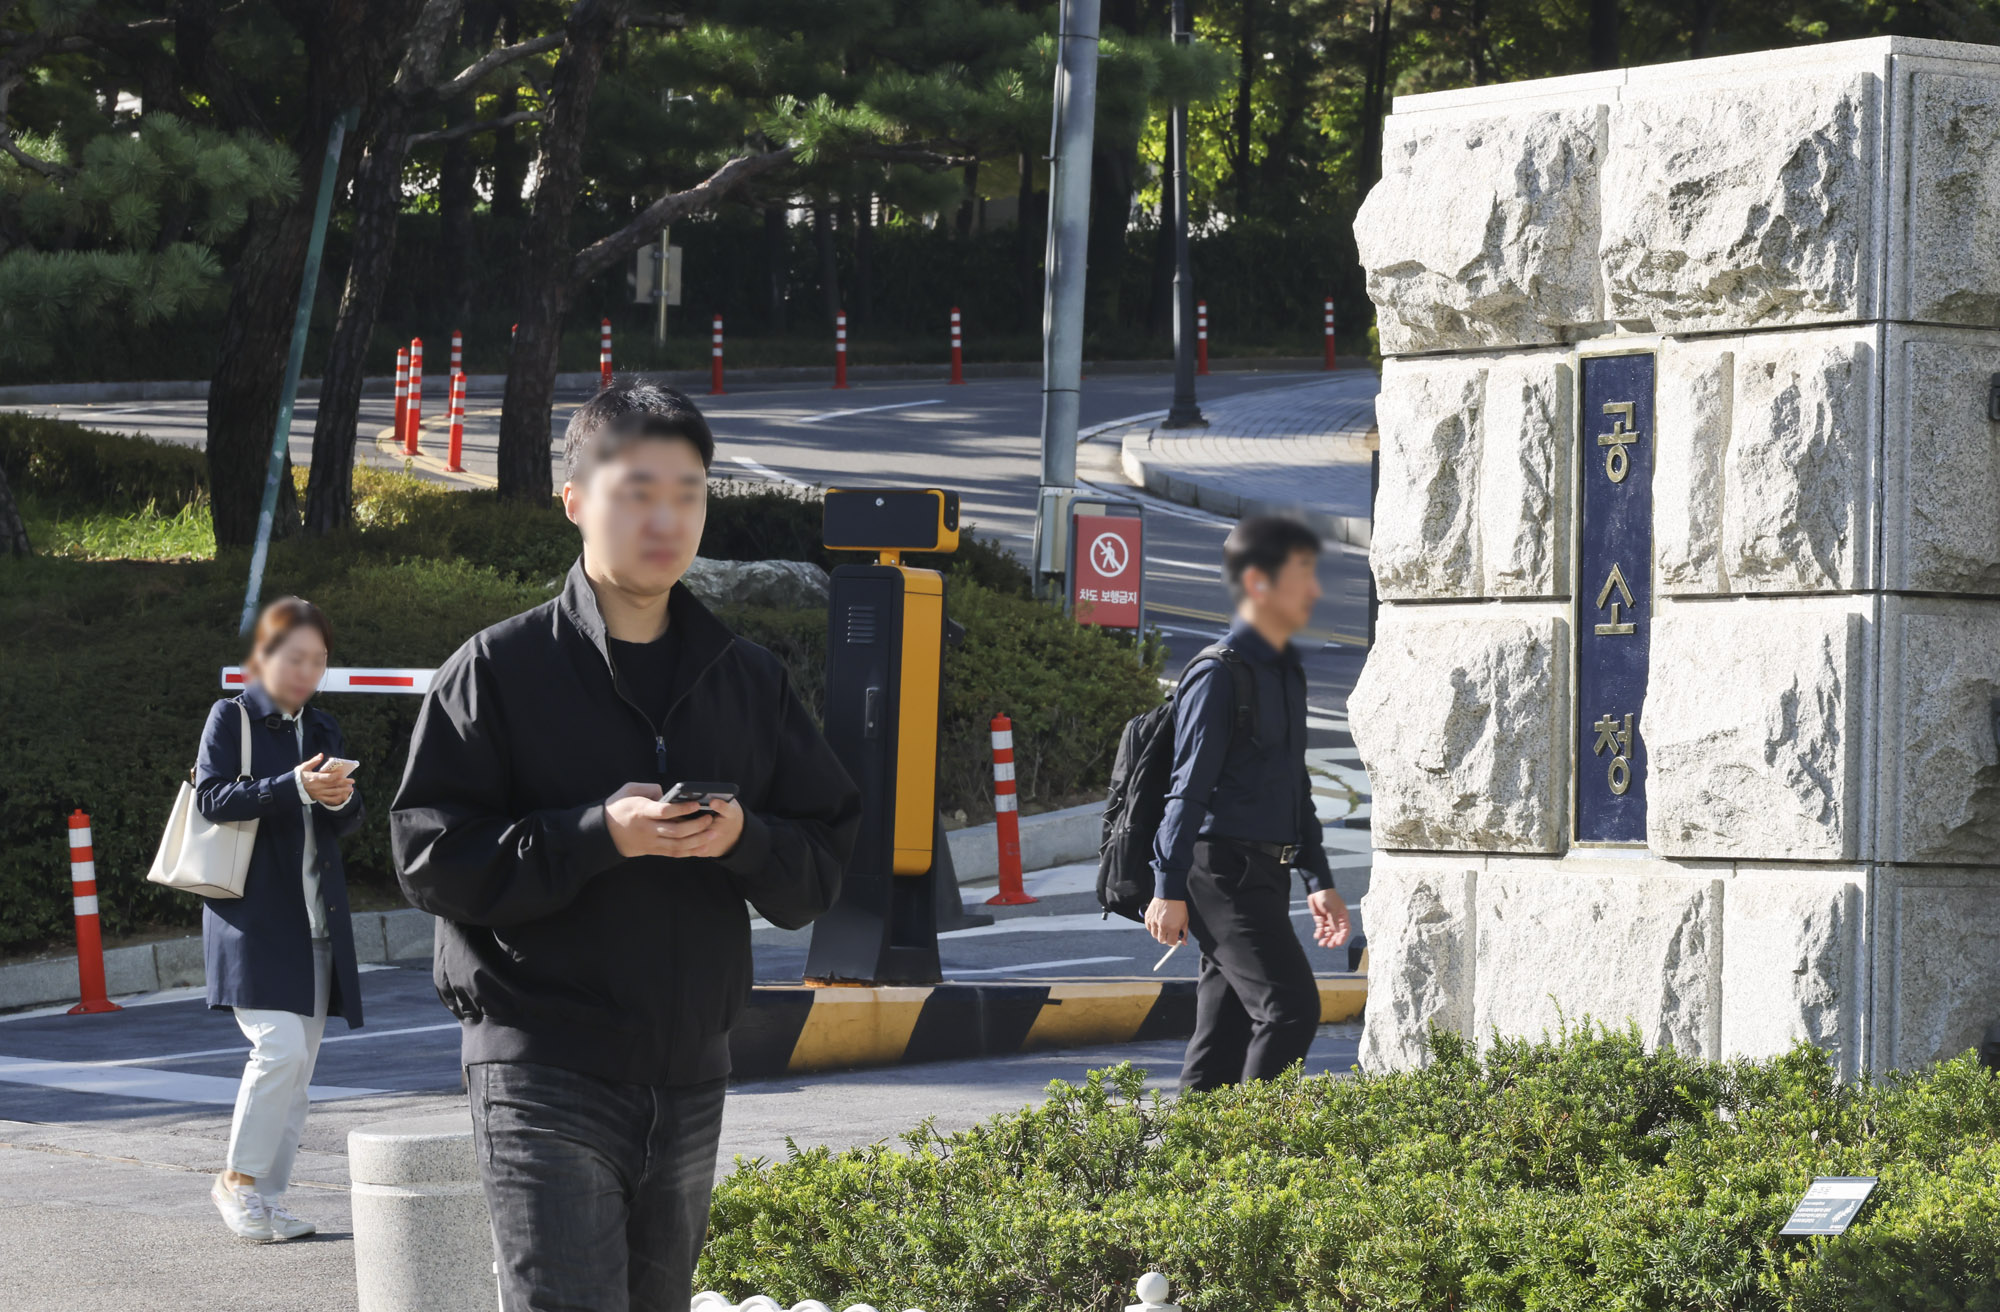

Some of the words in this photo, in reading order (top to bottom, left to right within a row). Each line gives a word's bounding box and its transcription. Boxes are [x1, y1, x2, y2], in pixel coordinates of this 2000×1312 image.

[1079, 588, 1099, 601] 차도
[1100, 589, 1137, 605] 보행금지
[1593, 401, 1639, 795] 공소청
